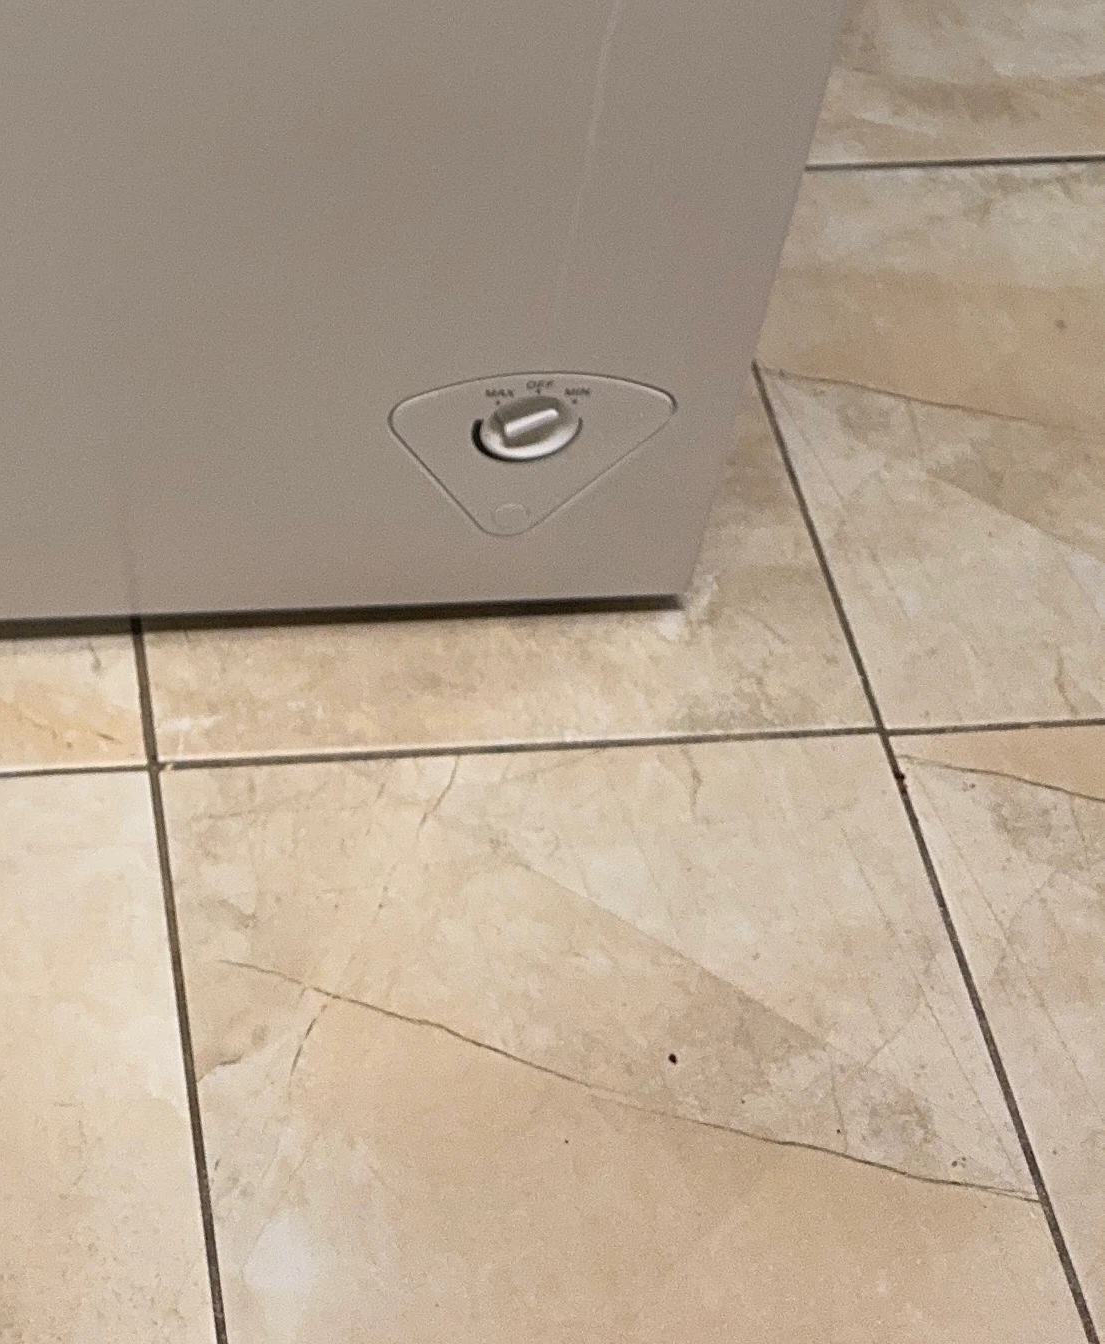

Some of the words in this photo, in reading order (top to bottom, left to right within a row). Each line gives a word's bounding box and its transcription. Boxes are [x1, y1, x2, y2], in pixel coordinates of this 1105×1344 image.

[525, 379, 555, 391] OFF
[485, 387, 514, 399] MAX
[564, 387, 591, 398] MIN
